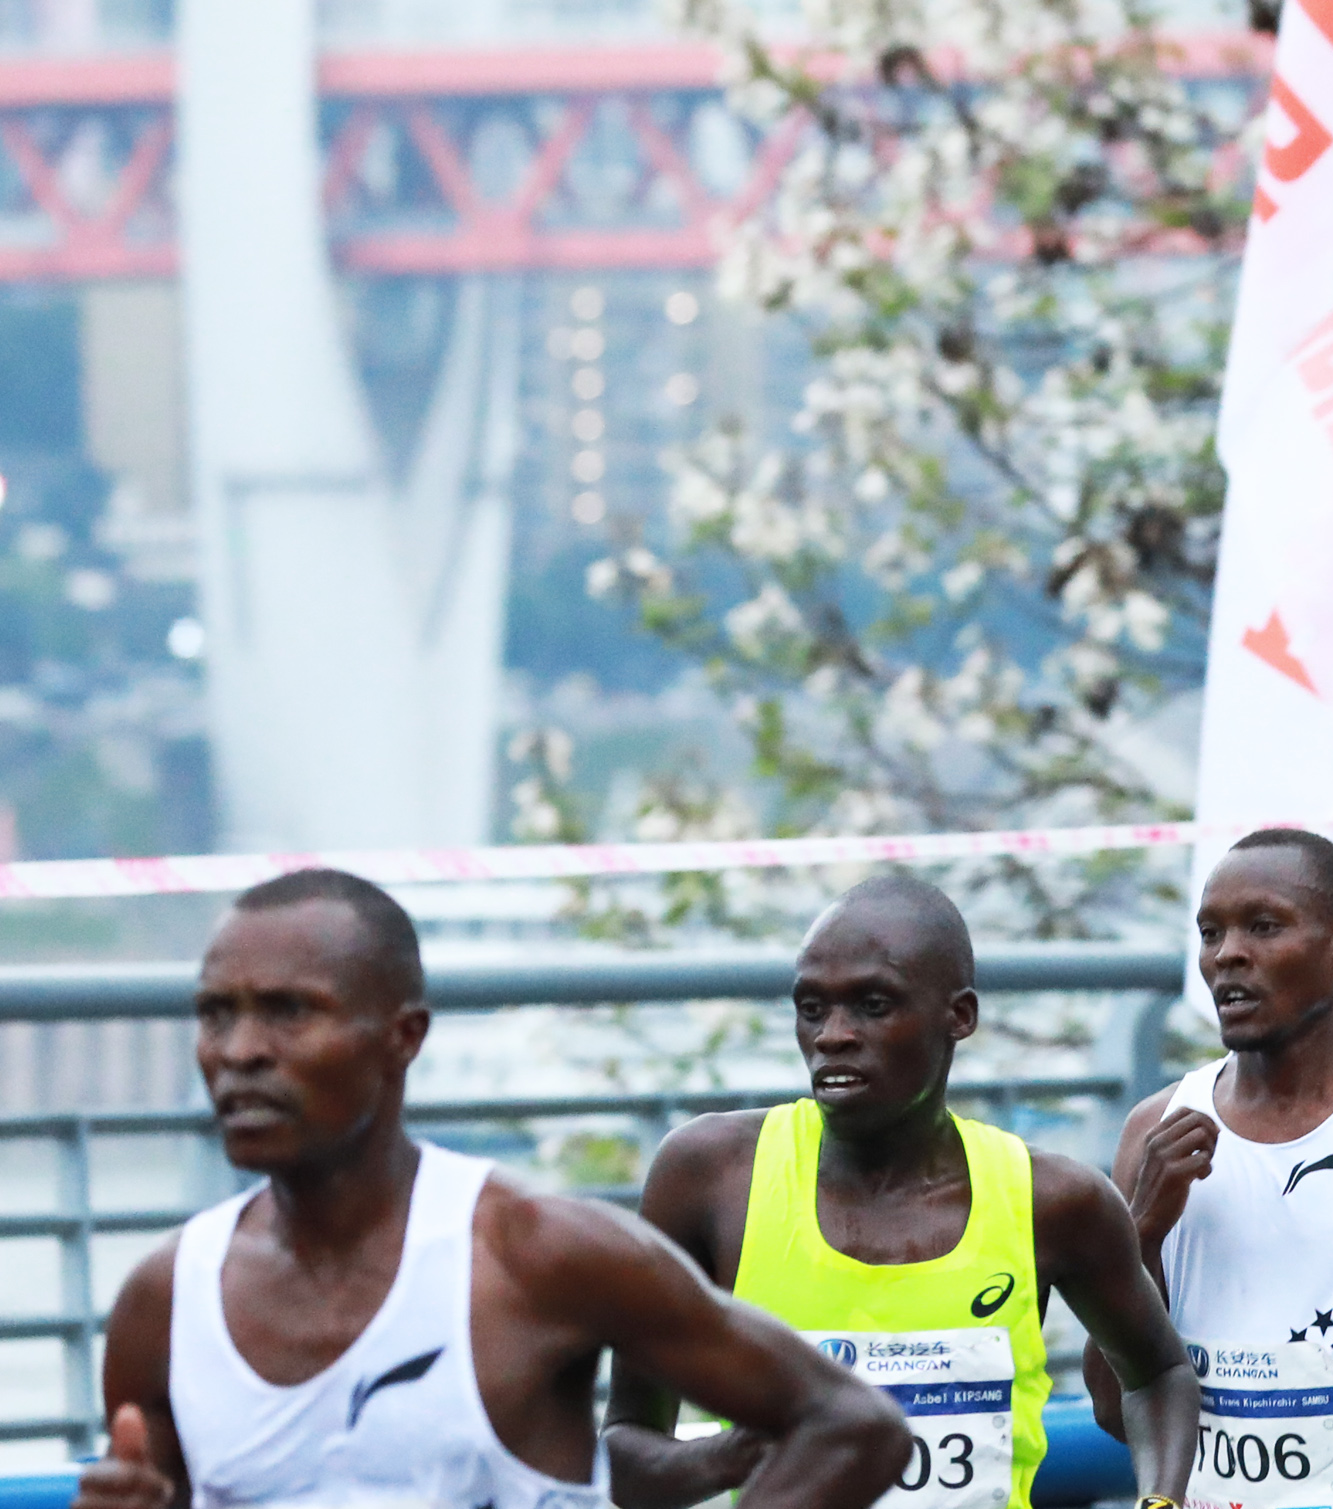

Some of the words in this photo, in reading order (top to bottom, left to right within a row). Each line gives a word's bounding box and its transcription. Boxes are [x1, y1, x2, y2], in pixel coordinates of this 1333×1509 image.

[867, 1341, 951, 1357] 长安汽车
[867, 1360, 951, 1372] CHANGAN
[1215, 1367, 1279, 1379] CHANGAN
[913, 1393, 948, 1405] Asbel
[954, 1390, 1003, 1403] KIPSANG
[1199, 1425, 1311, 1482] T006
